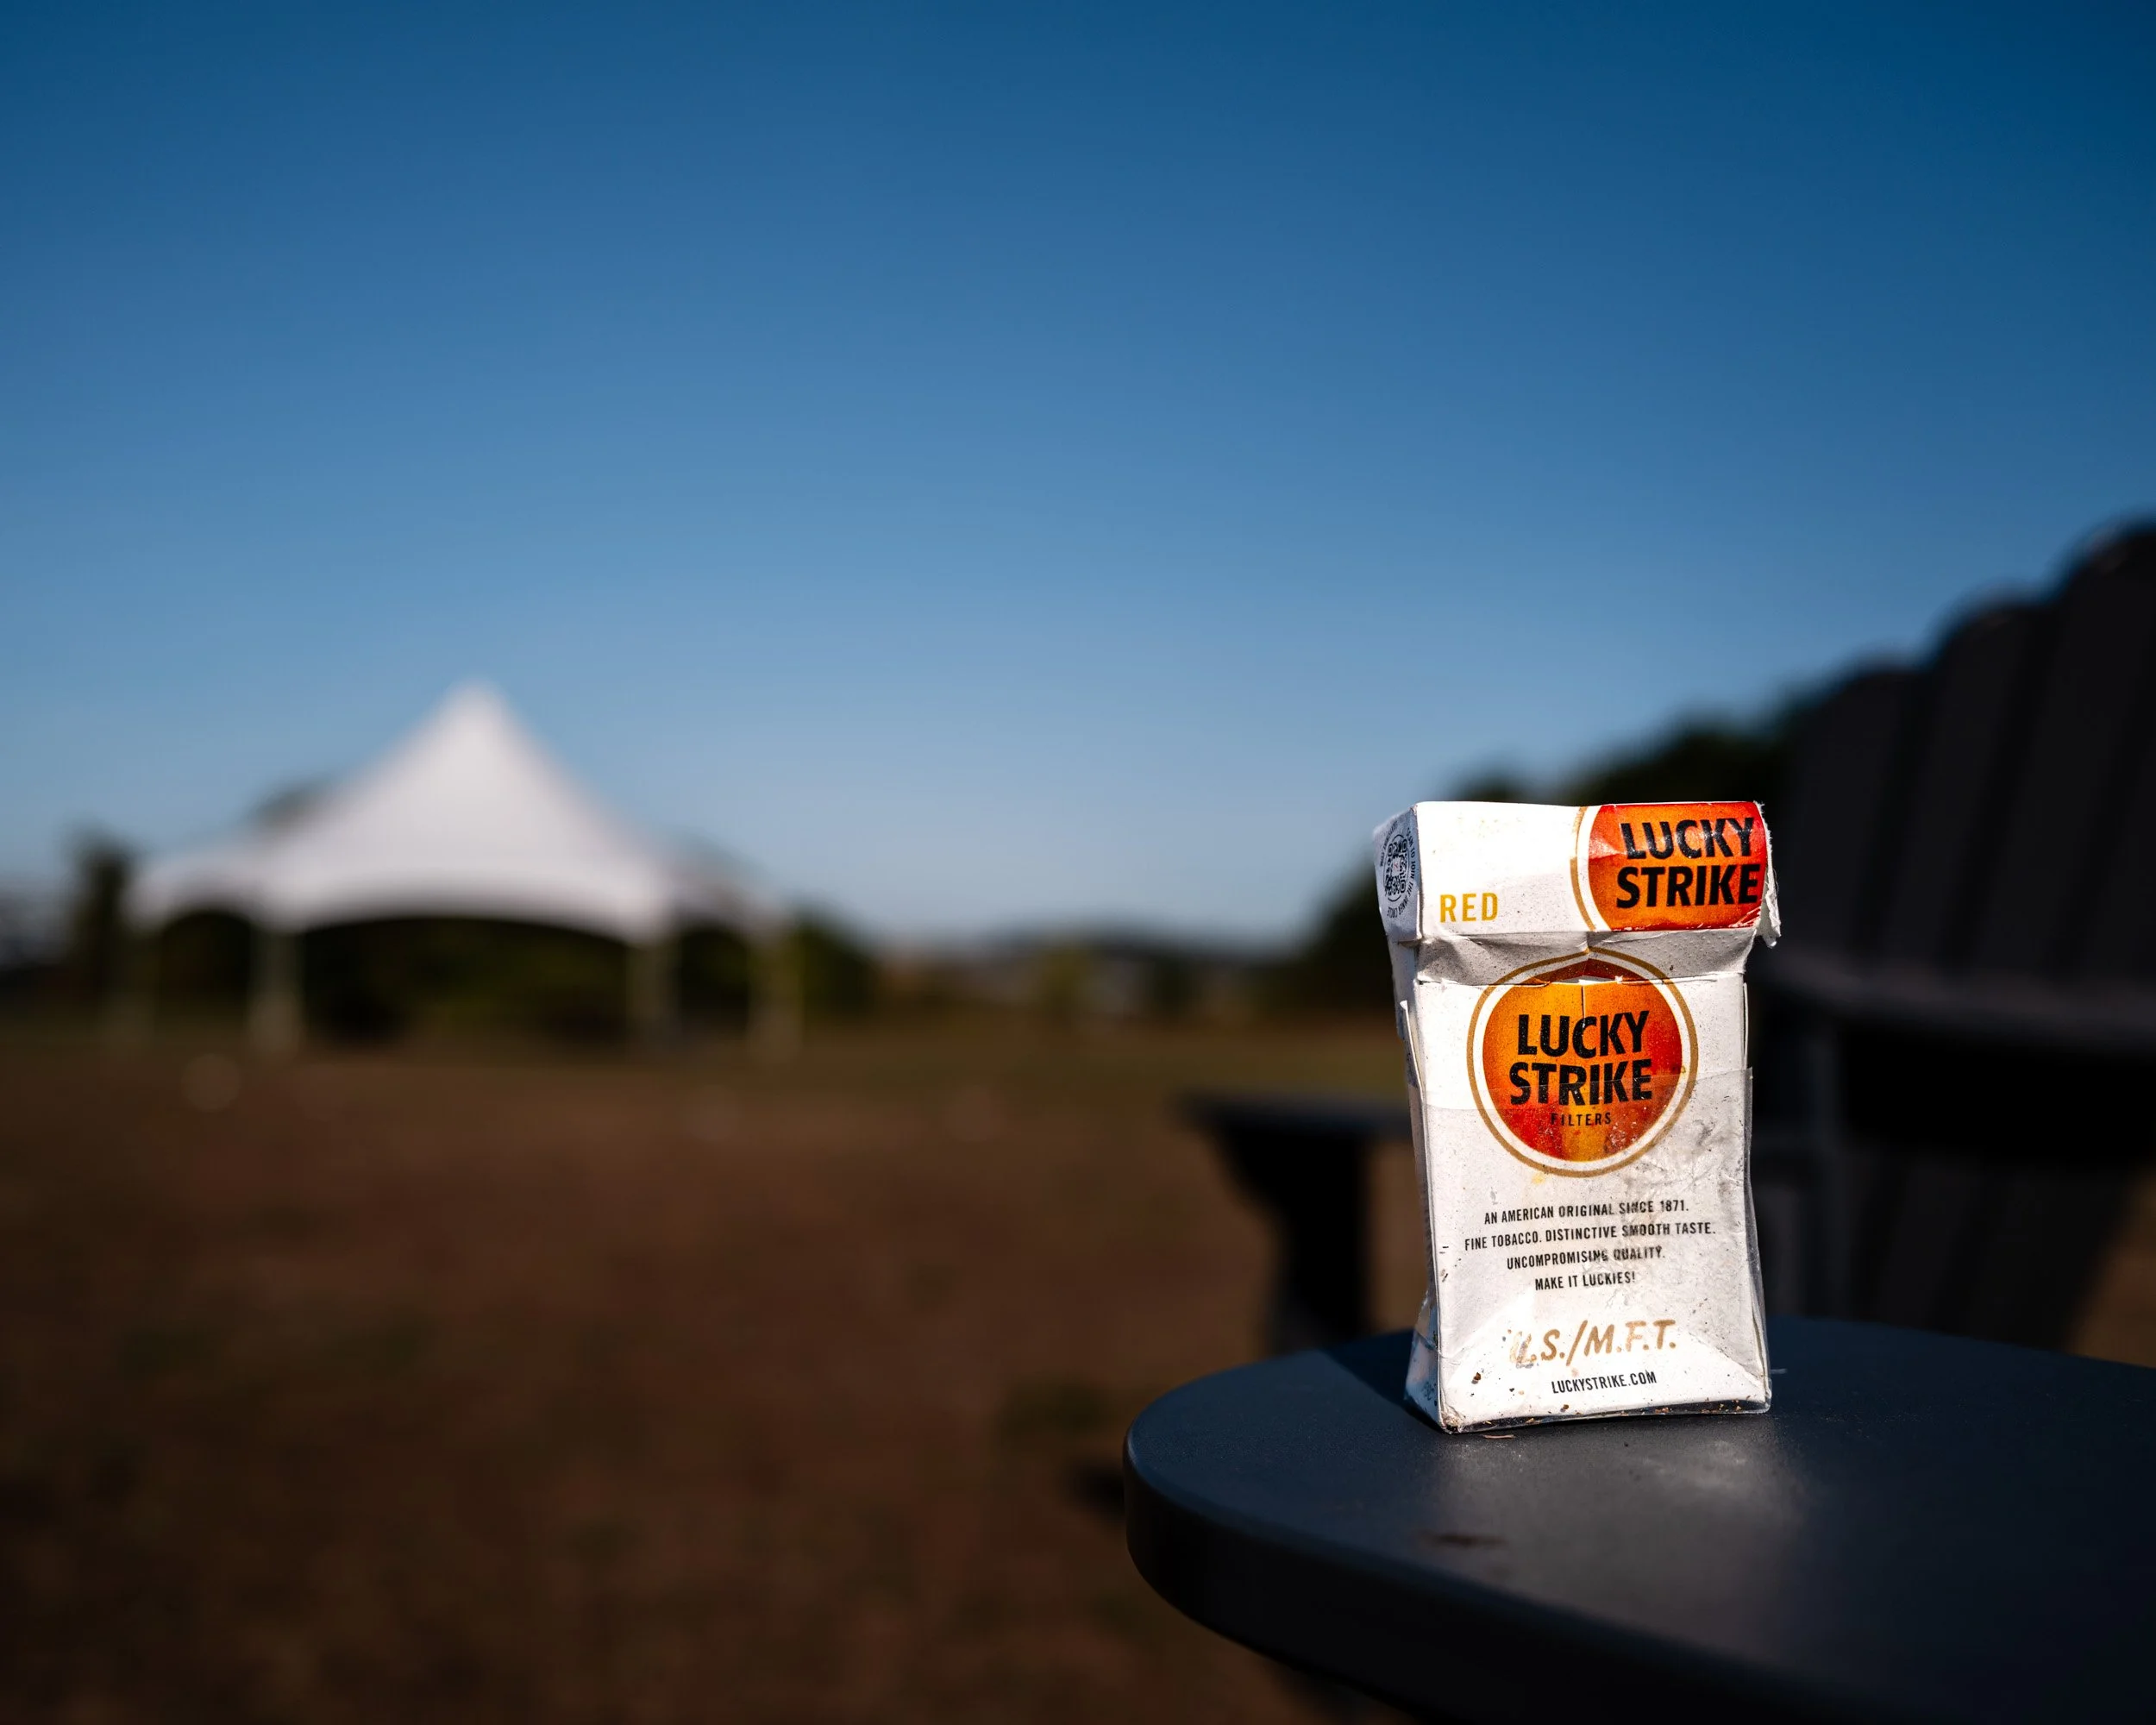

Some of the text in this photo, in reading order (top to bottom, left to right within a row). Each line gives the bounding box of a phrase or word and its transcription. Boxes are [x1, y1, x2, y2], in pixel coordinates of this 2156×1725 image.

[1620, 816, 1755, 861] LUCKY
[1616, 864, 1760, 909] STRIKE
[1439, 891, 1499, 924] RED
[1517, 1010, 1650, 1059] LUCKY
[1509, 1058, 1653, 1107] STRIKE
[1551, 1112, 1612, 1126] FILTERS
[1484, 1199, 1689, 1225] AN AMERICAN ORIGINAL SINCE 1871.
[1464, 1221, 1716, 1251] FINE TOBACCO. DISTINCTIVE SMOOTH TASTE.
[1507, 1245, 1666, 1270] UNCOMPROMISING QUALITY.
[1535, 1270, 1636, 1291] MAKE IT LUCKIES!
[1551, 1370, 1658, 1395] LUCKYSTRIKE.COM
